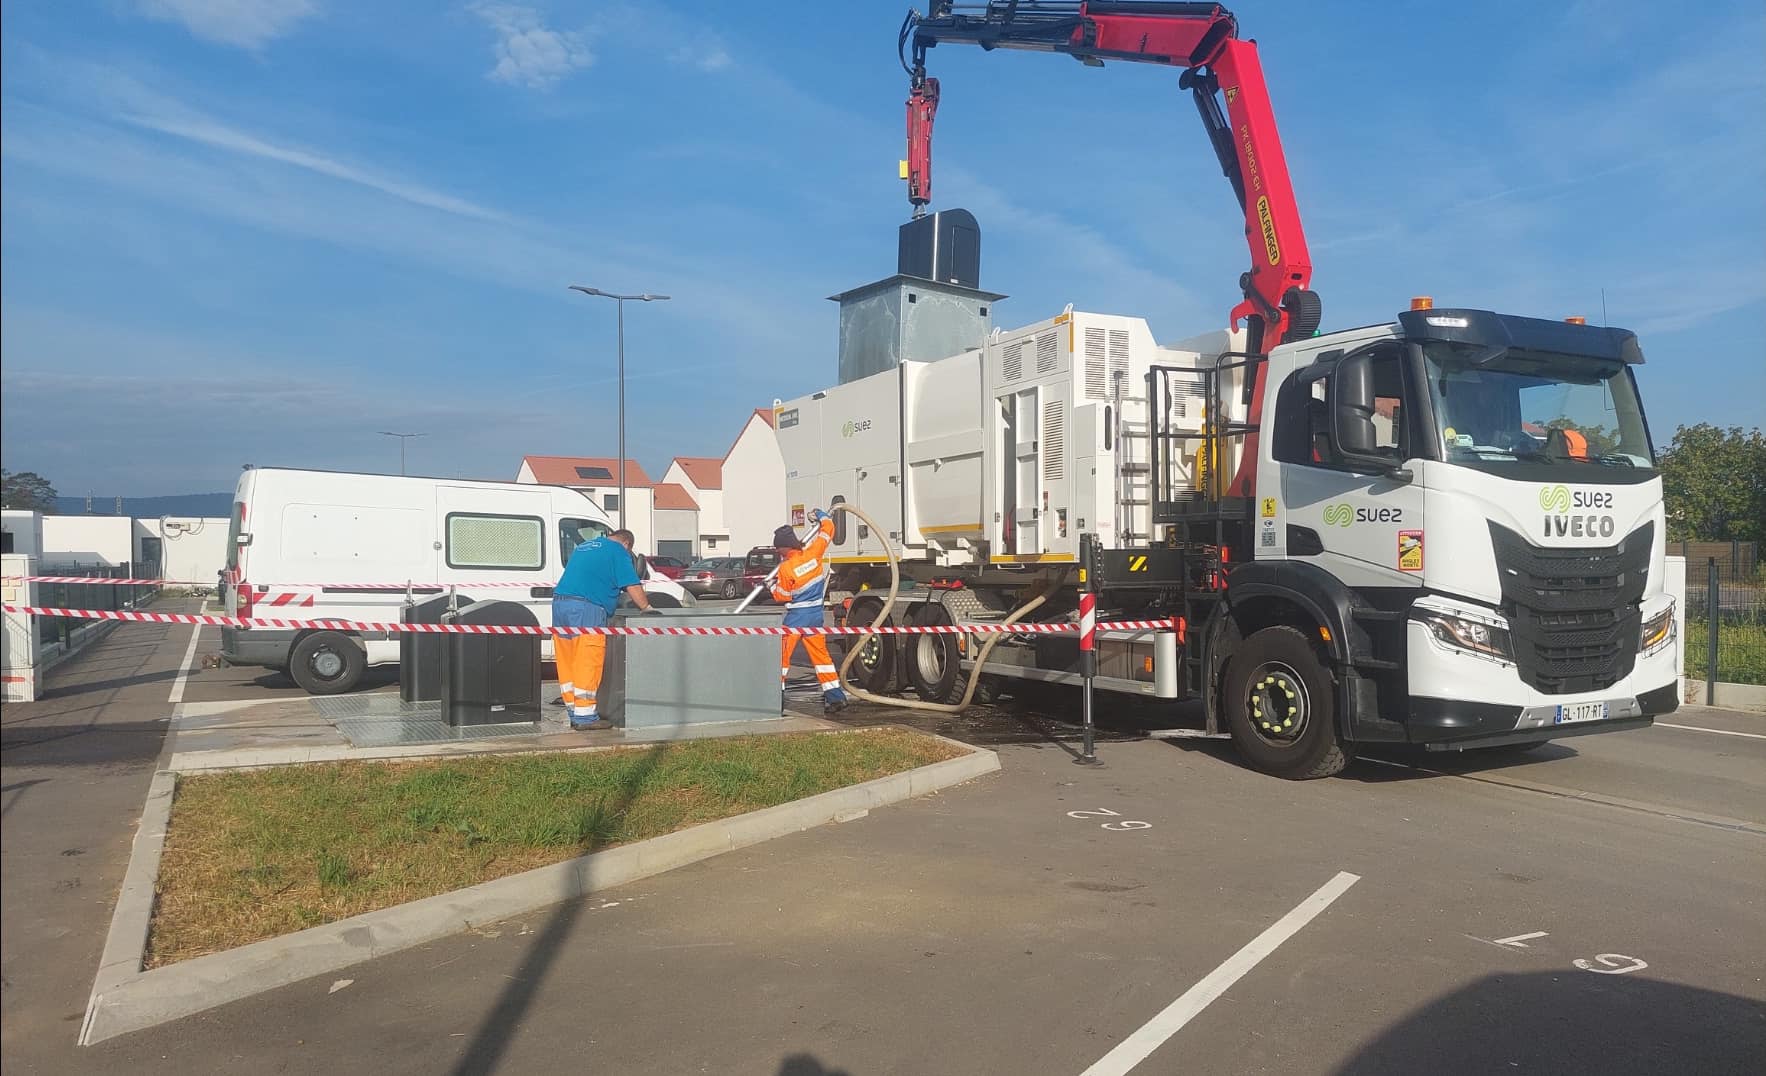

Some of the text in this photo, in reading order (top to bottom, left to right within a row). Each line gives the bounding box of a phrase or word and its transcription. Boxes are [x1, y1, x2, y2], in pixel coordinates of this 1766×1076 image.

[1258, 200, 1278, 262] PALFINGER
[854, 419, 872, 433] suez
[1573, 491, 1614, 508] suez
[1356, 508, 1403, 523] suez
[1544, 515, 1615, 538] IVECO
[1562, 704, 1603, 721] GL-117-RT
